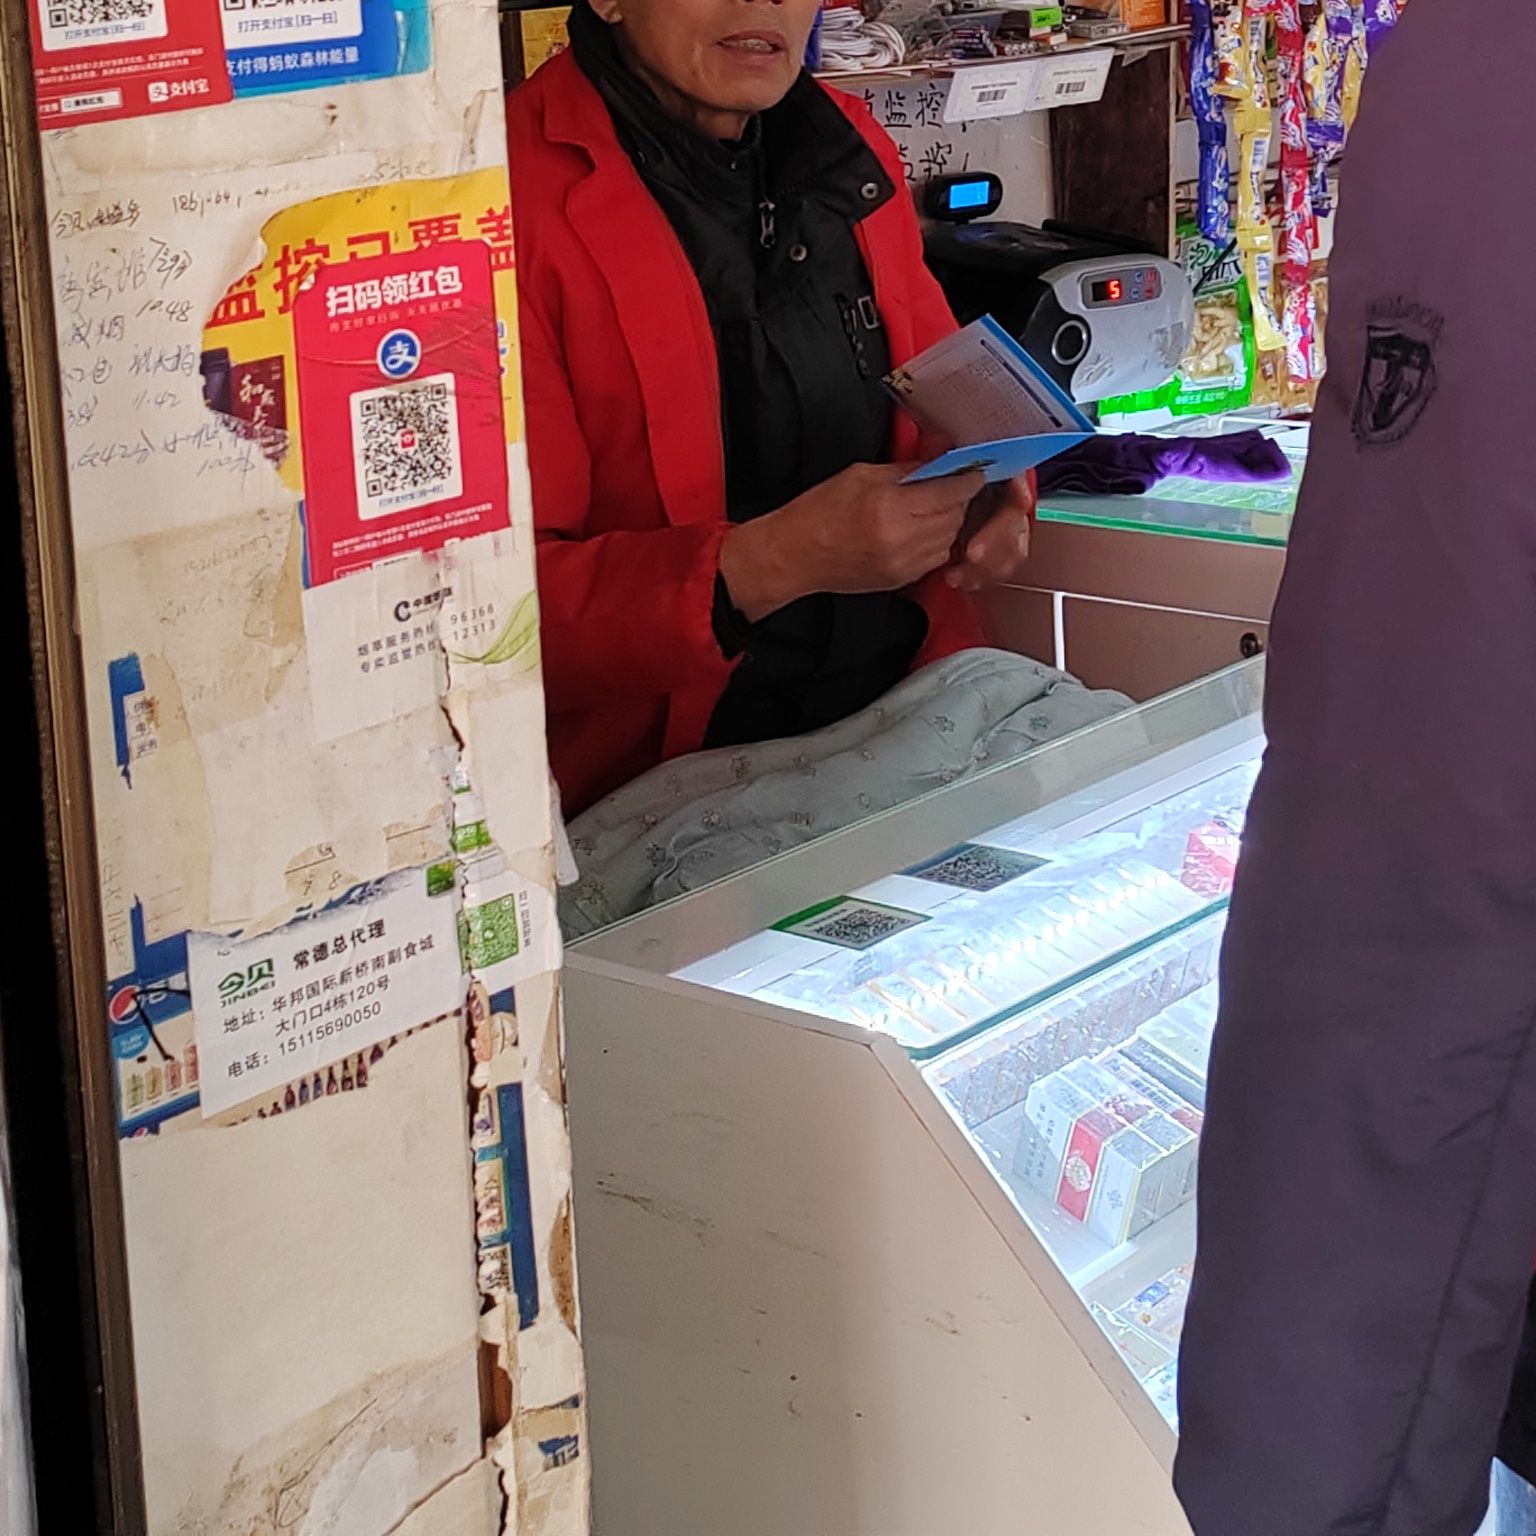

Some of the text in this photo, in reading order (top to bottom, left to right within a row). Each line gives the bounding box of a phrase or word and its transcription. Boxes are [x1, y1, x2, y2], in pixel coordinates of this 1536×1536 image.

[170, 78, 210, 97] 支付宝
[325, 265, 463, 318] 扫码领红包
[1108, 280, 1120, 299] 5
[450, 602, 495, 625] 96368
[452, 619, 497, 641] 12313
[293, 918, 387, 971] 常德总代理
[217, 958, 275, 999] 今贝
[274, 973, 391, 1038] 大门口4栋120号
[278, 1000, 382, 1056] 15115690050
